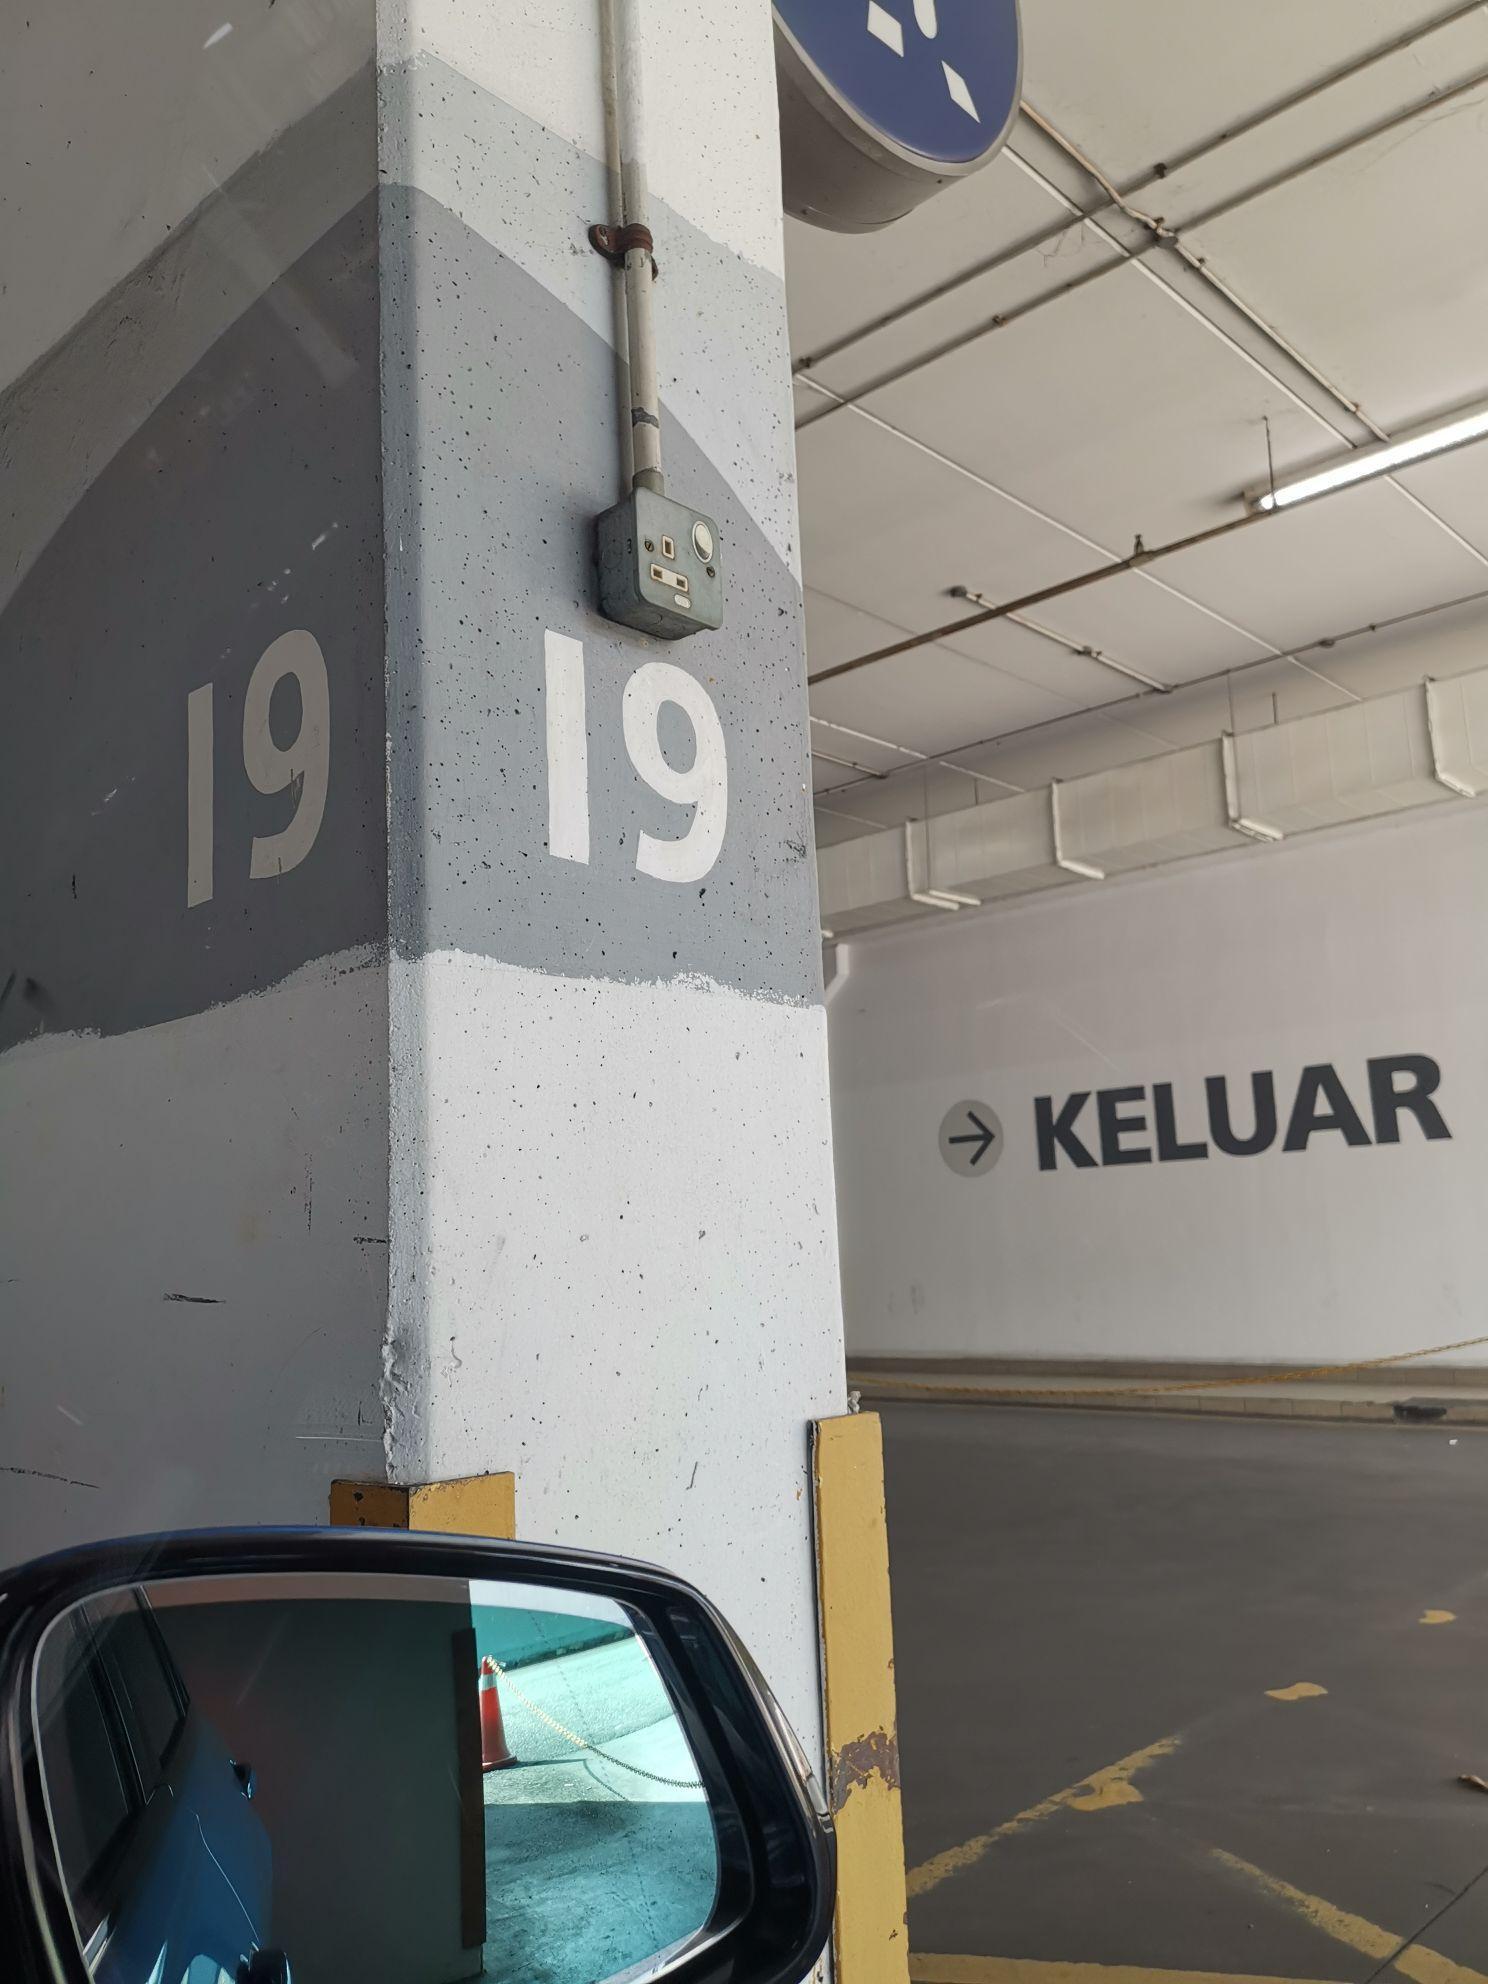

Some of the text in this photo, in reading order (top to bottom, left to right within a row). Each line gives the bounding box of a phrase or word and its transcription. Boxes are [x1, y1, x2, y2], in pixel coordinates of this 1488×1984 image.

[187, 629, 330, 908] 19
[544, 628, 728, 883] 19
[1034, 1055, 1452, 1171] KELUAR
